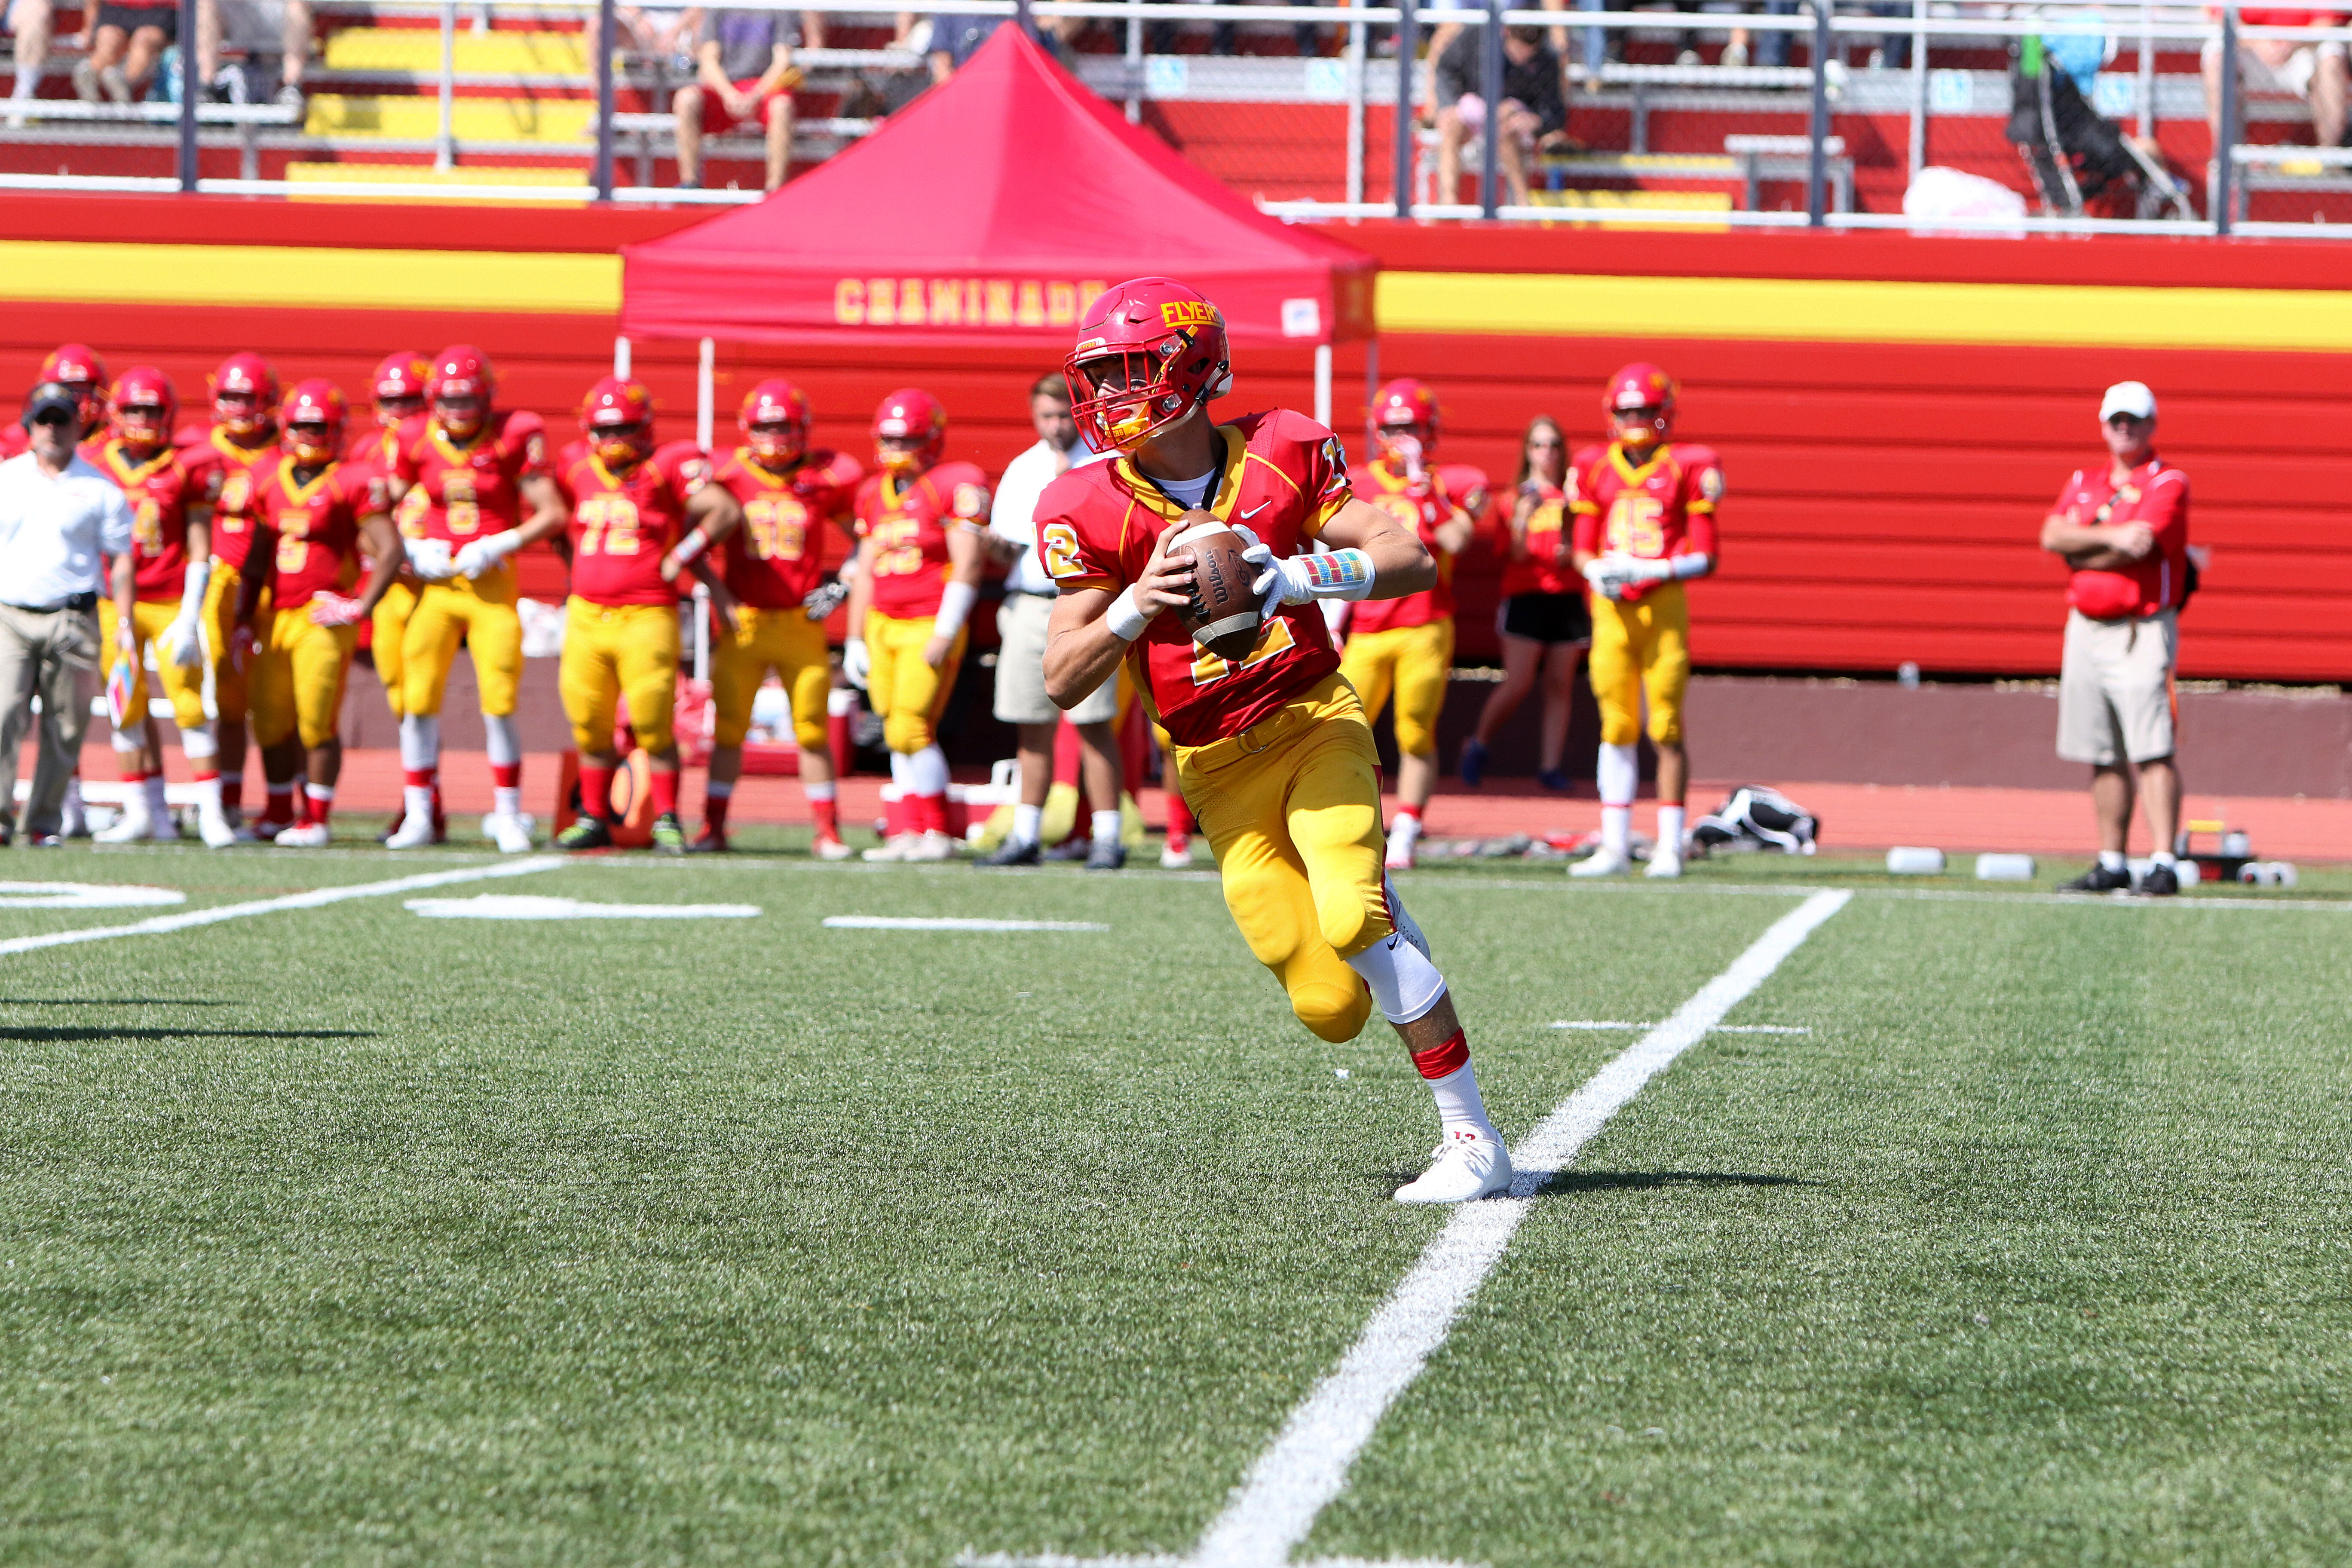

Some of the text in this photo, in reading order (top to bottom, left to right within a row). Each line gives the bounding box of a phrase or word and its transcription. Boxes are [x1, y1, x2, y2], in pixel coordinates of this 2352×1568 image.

[1160, 301, 1224, 324] FLYERS
[577, 499, 640, 557] 72
[1032, 522, 1088, 579] 2
[1606, 497, 1664, 558] 45
[1205, 549, 1229, 606] Wilson
